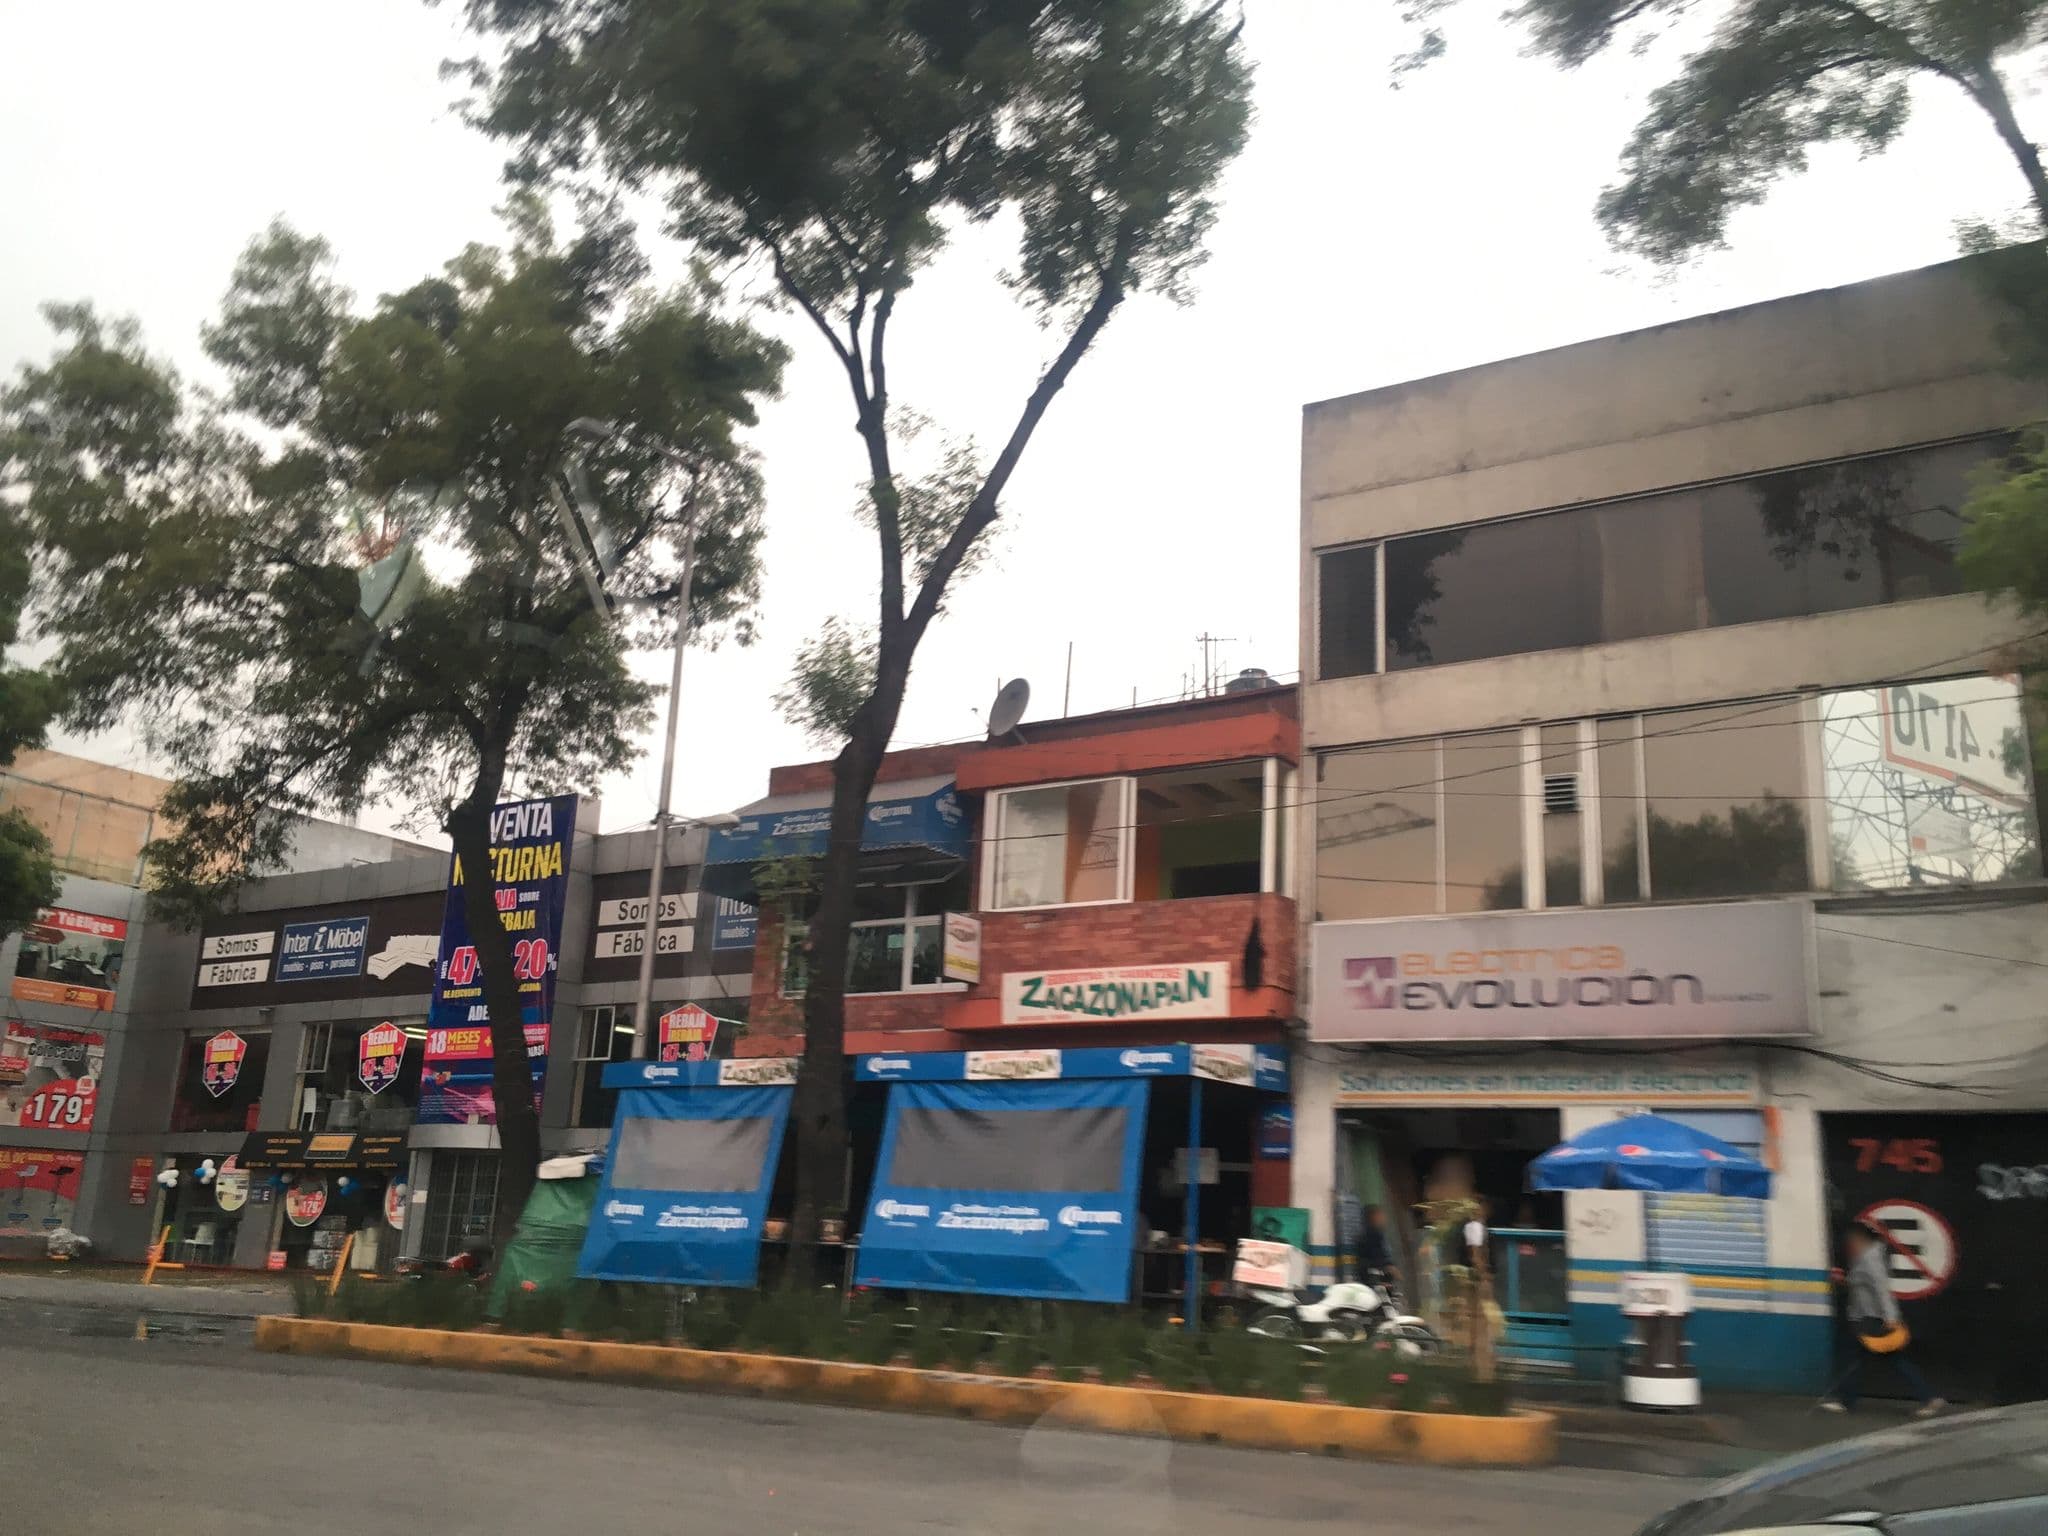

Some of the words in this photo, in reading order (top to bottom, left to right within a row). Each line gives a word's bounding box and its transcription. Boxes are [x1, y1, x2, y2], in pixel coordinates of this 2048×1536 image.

[490, 802, 552, 844] VENTA
[216, 938, 258, 955] Somos
[283, 934, 312, 954] Inter
[326, 926, 366, 950] Möbel
[613, 932, 677, 955] Fábca
[210, 965, 257, 984] Fábrica
[1019, 968, 1211, 1017] ZACAZONAPAN
[669, 1013, 706, 1029] REBAJA
[428, 1031, 447, 1054] 18
[447, 1031, 480, 1044] MESES
